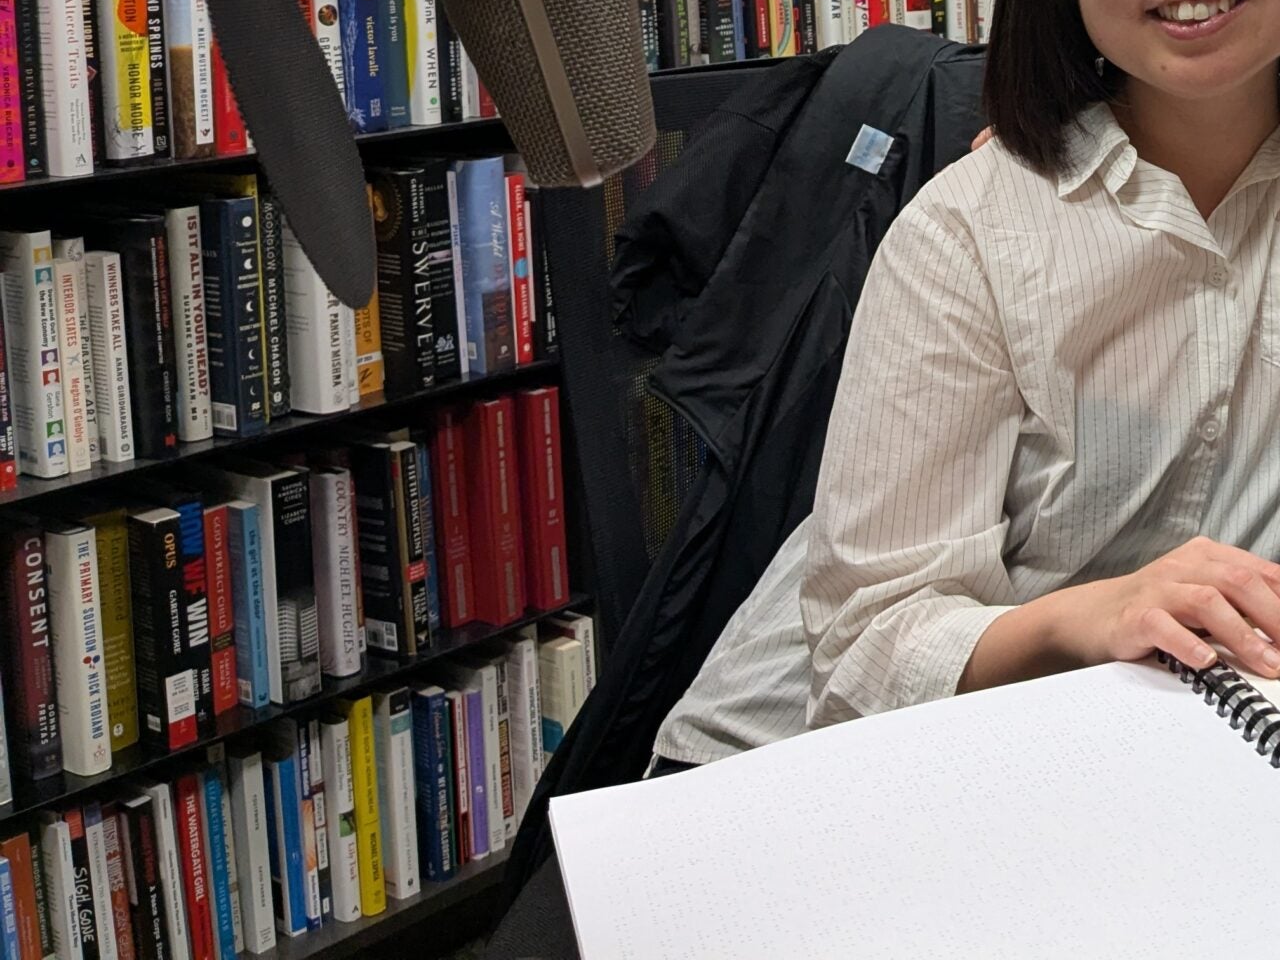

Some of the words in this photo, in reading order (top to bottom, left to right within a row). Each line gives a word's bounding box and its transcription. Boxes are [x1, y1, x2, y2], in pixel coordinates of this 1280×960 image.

[390, 16, 398, 24] is
[425, 0, 434, 24] Pink
[148, 18, 162, 69] SPRINGS
[366, 16, 376, 45] victor
[389, 25, 398, 42] you
[68, 49, 80, 90] Traits
[368, 47, 379, 77] lavalle
[427, 47, 437, 89] WHEN
[25, 68, 36, 100] DEVIN
[127, 63, 141, 99] HONOR
[130, 103, 142, 139] MOORE
[186, 215, 197, 232] IS
[188, 233, 198, 248] IT
[190, 252, 200, 280] ALL
[62, 274, 75, 314] INTERIOR
[107, 262, 119, 306] WINNERS
[191, 284, 201, 300] IN
[412, 241, 433, 347] SWERVE
[111, 309, 121, 331] TAKE
[267, 278, 278, 333] MICHAEL
[66, 317, 77, 347] STATES
[192, 303, 204, 346] YOUR
[329, 313, 340, 347] PANKAJ
[113, 335, 122, 350] ALL
[196, 349, 209, 397] HEAD?
[271, 337, 281, 385] CHABON
[331, 350, 342, 386] MISHRA
[71, 377, 81, 407] Meghan
[77, 540, 90, 559] THE
[164, 533, 176, 568] OPUS
[79, 562, 93, 604] PRIMARY
[335, 481, 348, 538] COUNTRY
[342, 603, 354, 654] HUGHES
[25, 538, 48, 648] CONSENT
[169, 590, 179, 628] GARETH
[83, 607, 97, 653] SOLUTION
[187, 598, 208, 647] WIN
[172, 629, 181, 654] GORE
[88, 673, 100, 696] NICK
[38, 704, 48, 745] FREITAS
[48, 704, 57, 738] DONNA
[90, 698, 103, 740] TROIANO
[185, 795, 196, 815] THE
[187, 816, 201, 876] WATERGATE
[347, 842, 356, 859] Lily
[73, 867, 91, 907] SIGH,
[349, 862, 357, 881] Tuck
[194, 878, 204, 901] GIRL
[80, 910, 95, 943] GONE
